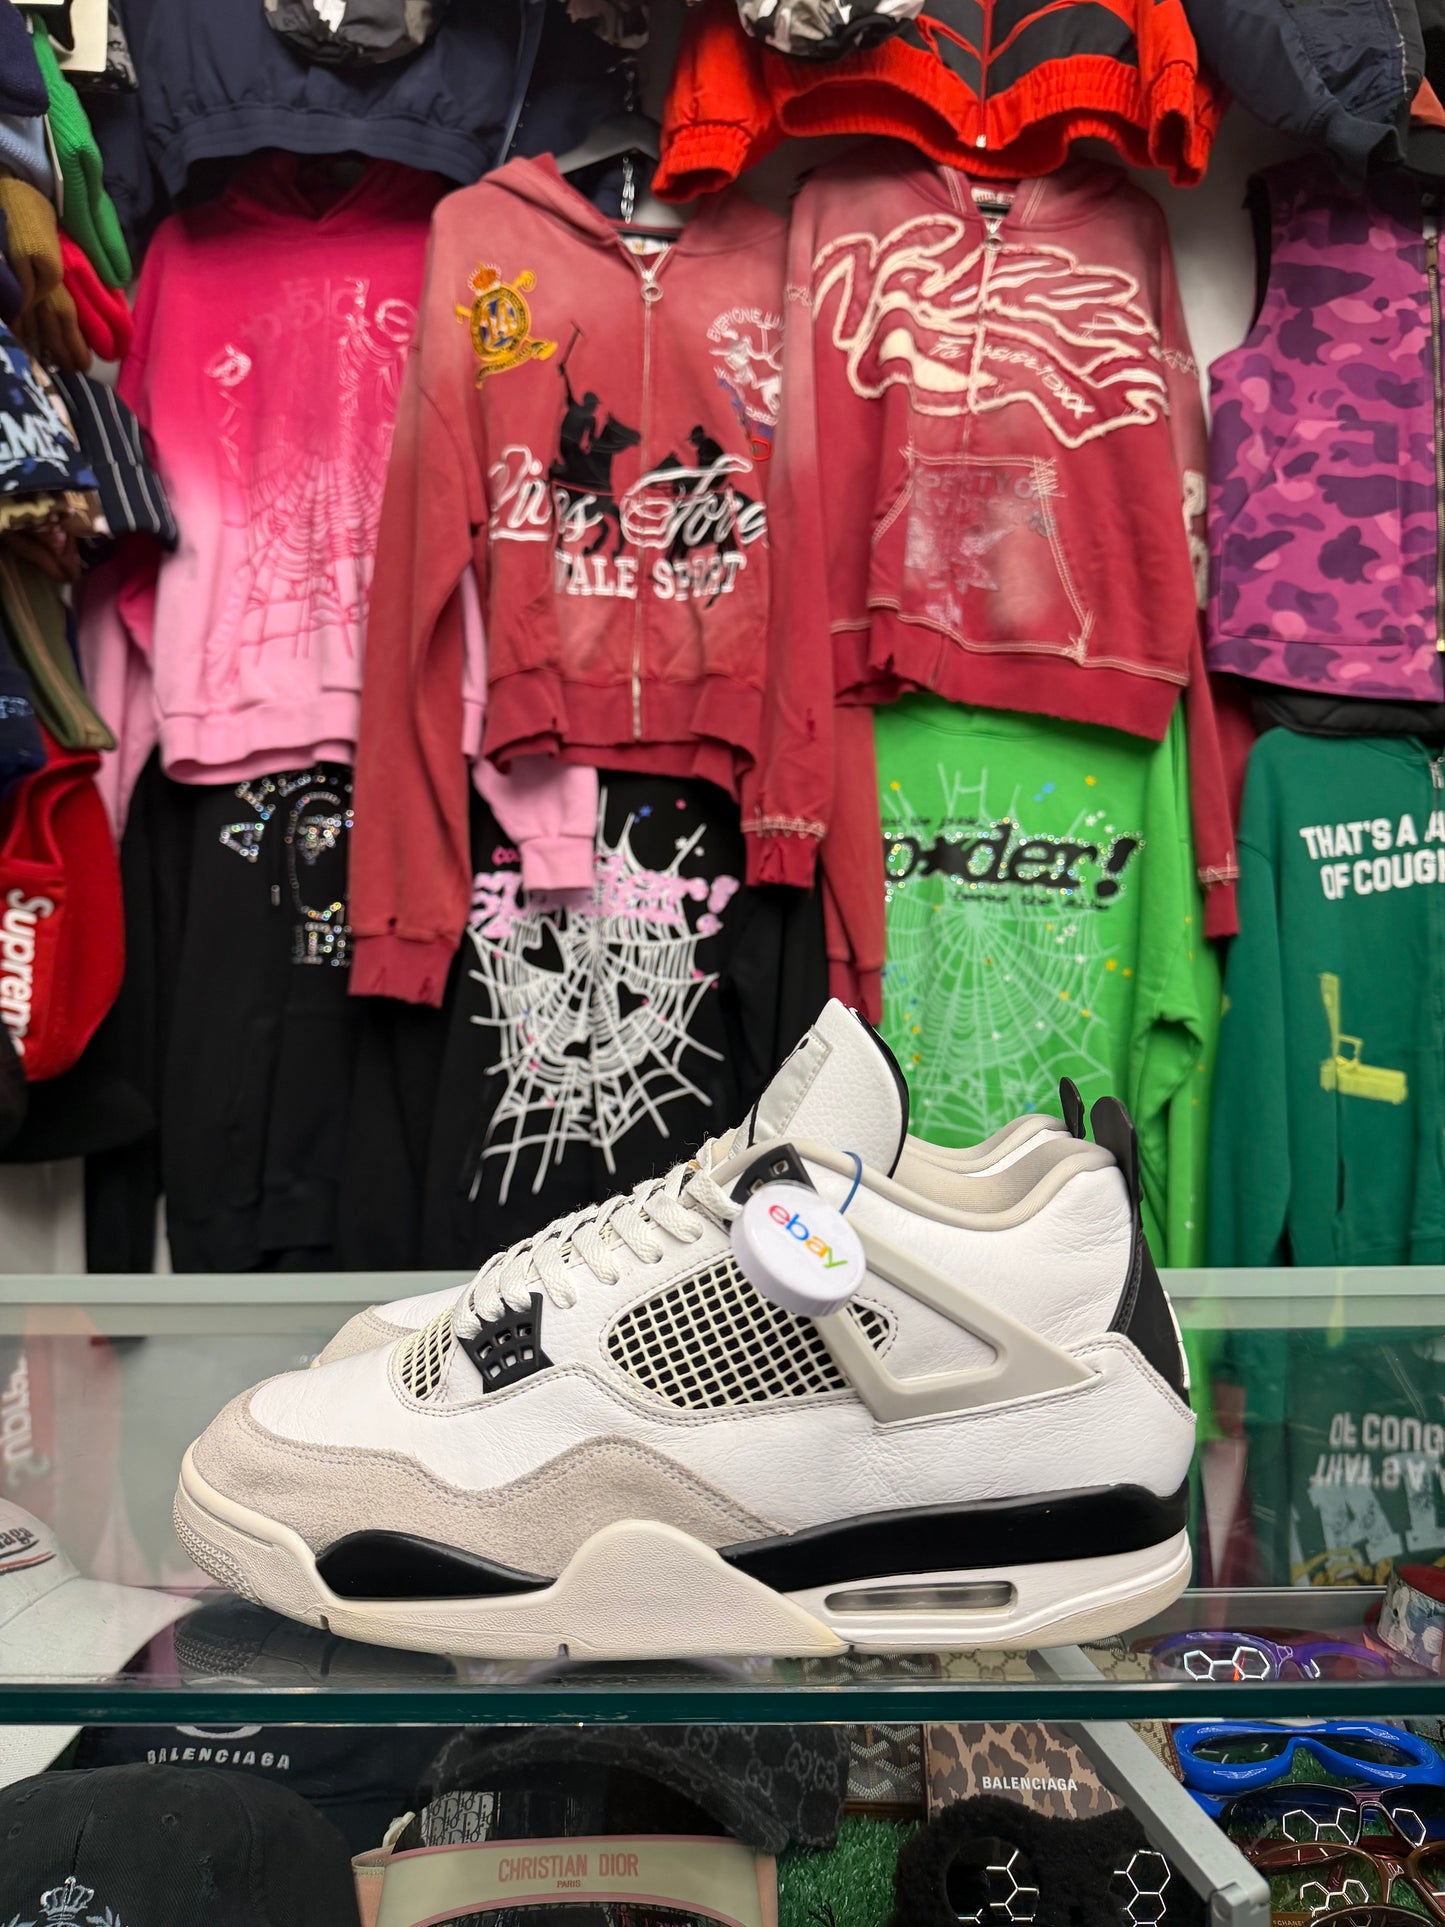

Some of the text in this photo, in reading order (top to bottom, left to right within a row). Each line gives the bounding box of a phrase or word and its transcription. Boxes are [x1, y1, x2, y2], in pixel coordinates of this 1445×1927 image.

[1299, 817, 1394, 861] THAT'S
[1395, 812, 1419, 848] A
[1320, 862, 1350, 900] OF
[768, 1204, 849, 1269] ebay
[146, 1746, 292, 1771] BALENCIAGA
[981, 1775, 1079, 1792] BALENCIAGA
[498, 1853, 639, 1883] CHRISTIAN DIOR
[556, 1878, 581, 1890] PARIS
